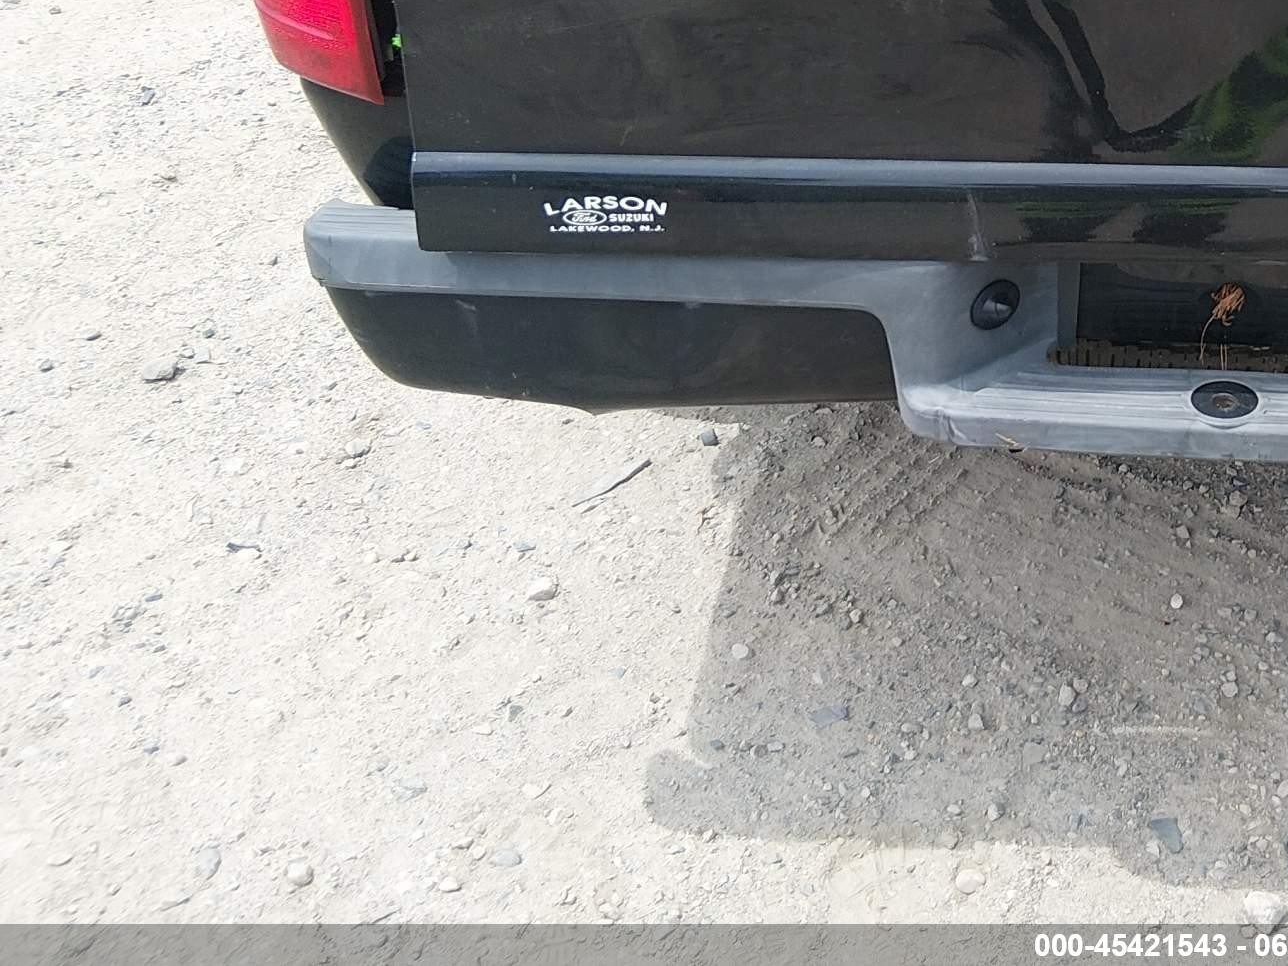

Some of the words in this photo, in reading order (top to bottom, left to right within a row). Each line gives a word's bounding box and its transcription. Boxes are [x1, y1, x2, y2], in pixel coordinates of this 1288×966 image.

[543, 195, 668, 216] LARSON
[608, 213, 654, 223] SUZUKI
[550, 225, 635, 233] LAKEWOOD,
